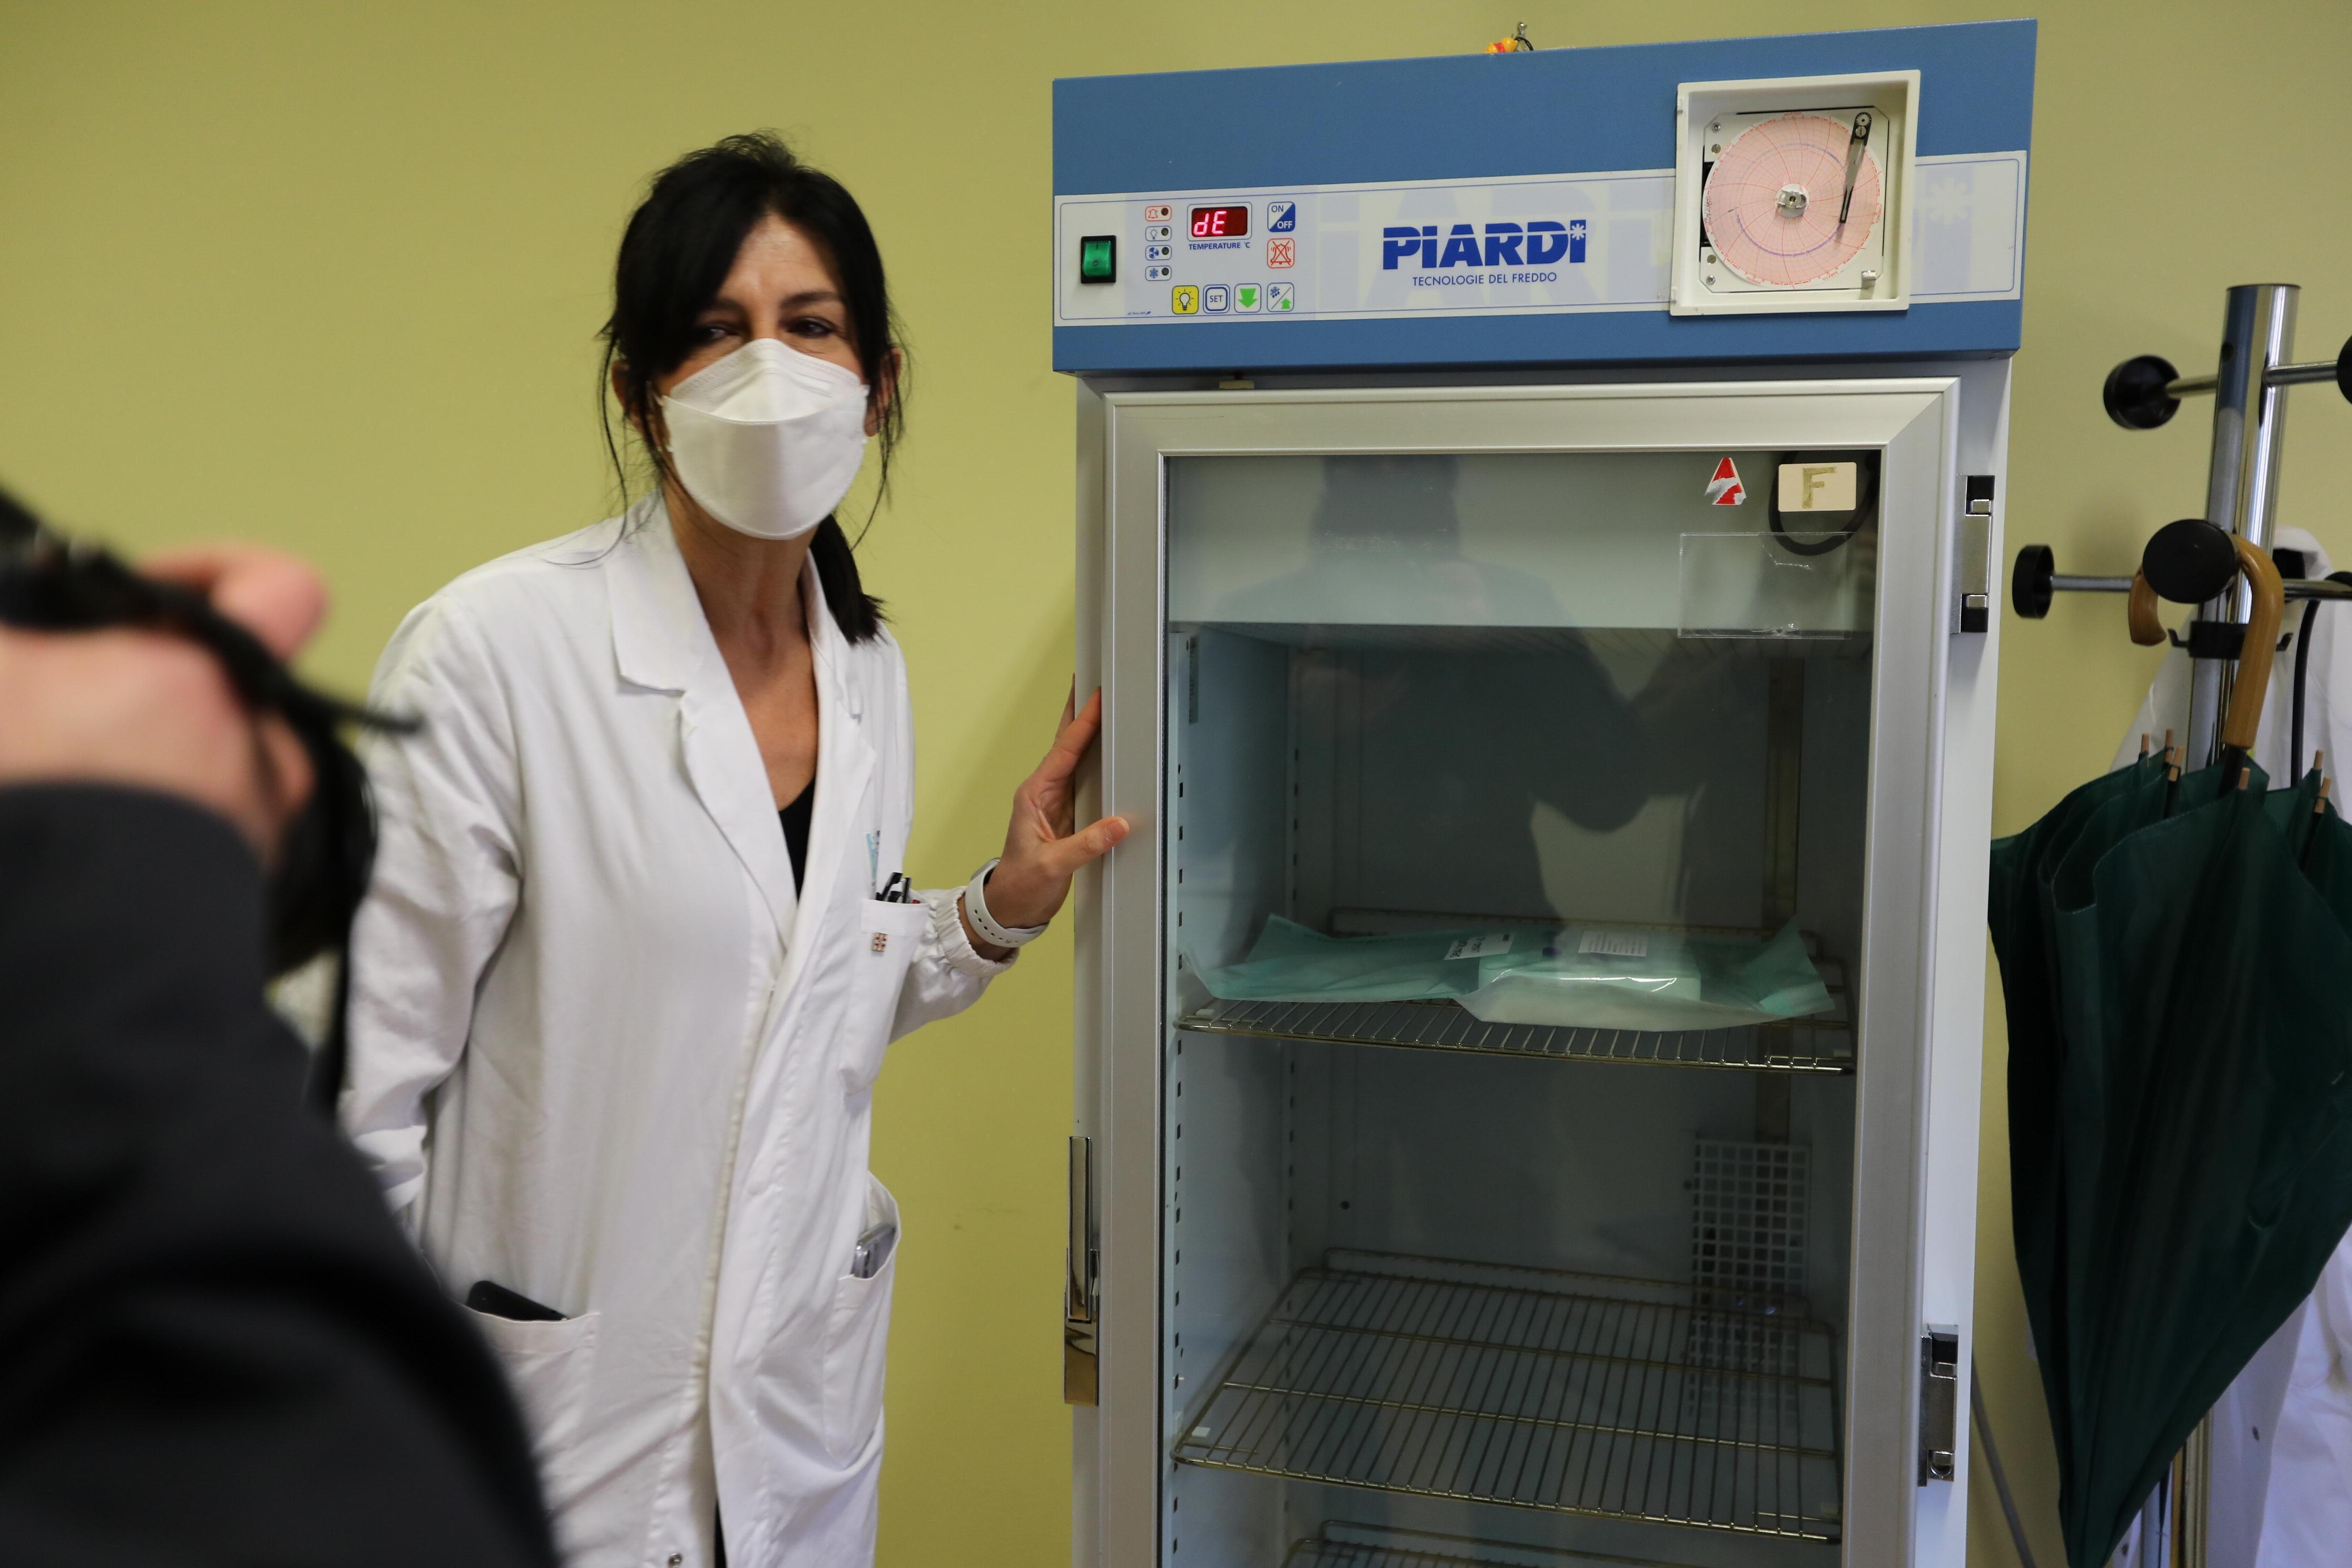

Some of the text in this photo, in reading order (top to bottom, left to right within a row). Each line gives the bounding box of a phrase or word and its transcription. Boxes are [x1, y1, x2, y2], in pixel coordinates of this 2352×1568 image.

[1383, 219, 1586, 270] PIARDI
[1413, 272, 1557, 286] TECNOLOGIE DEL FREDDO
[1802, 467, 1837, 508] F
